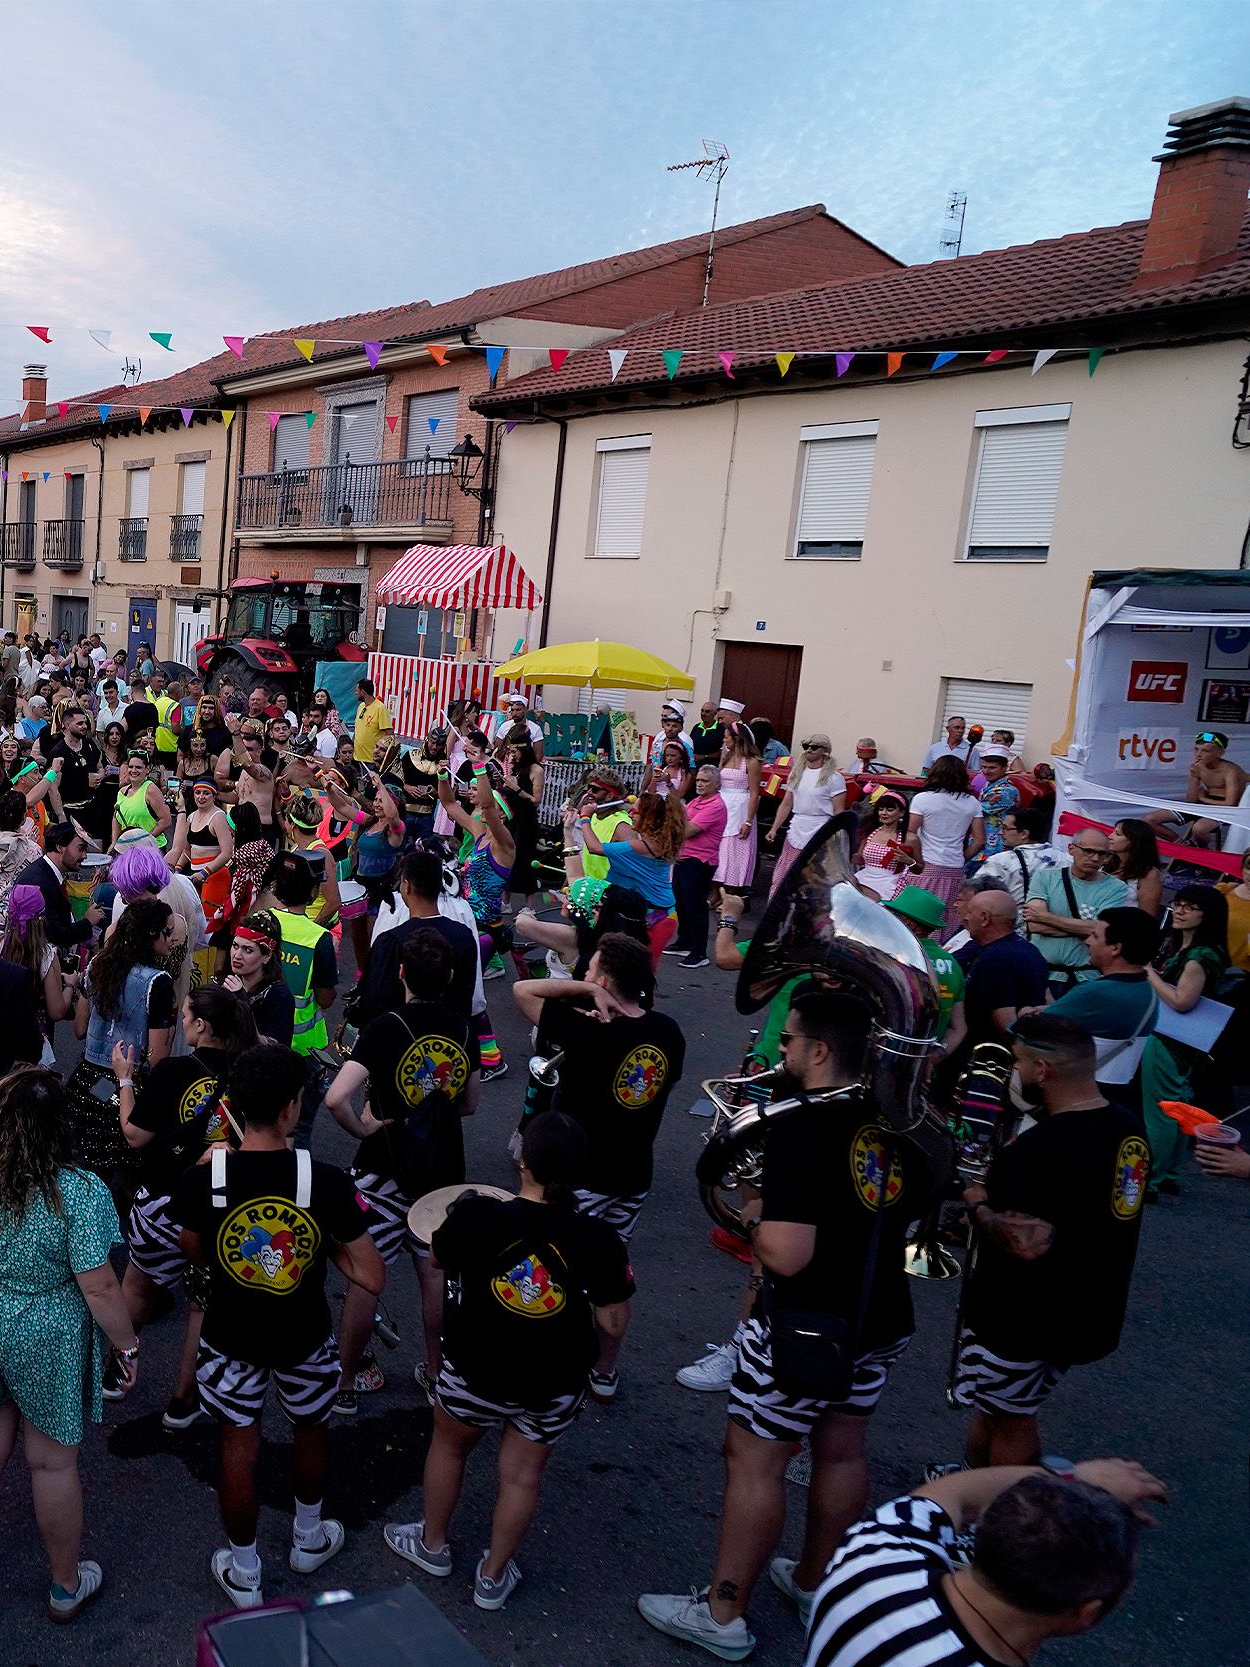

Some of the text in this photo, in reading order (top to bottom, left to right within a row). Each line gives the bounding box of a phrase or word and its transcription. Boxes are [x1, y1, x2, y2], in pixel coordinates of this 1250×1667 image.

[1134, 673, 1182, 691] UFC
[1118, 733, 1177, 763] rtve
[404, 1053, 422, 1086] DOS
[618, 1062, 634, 1088] DOS
[185, 1089, 202, 1118] DOS
[225, 1205, 312, 1263] DOS ROMBOS
